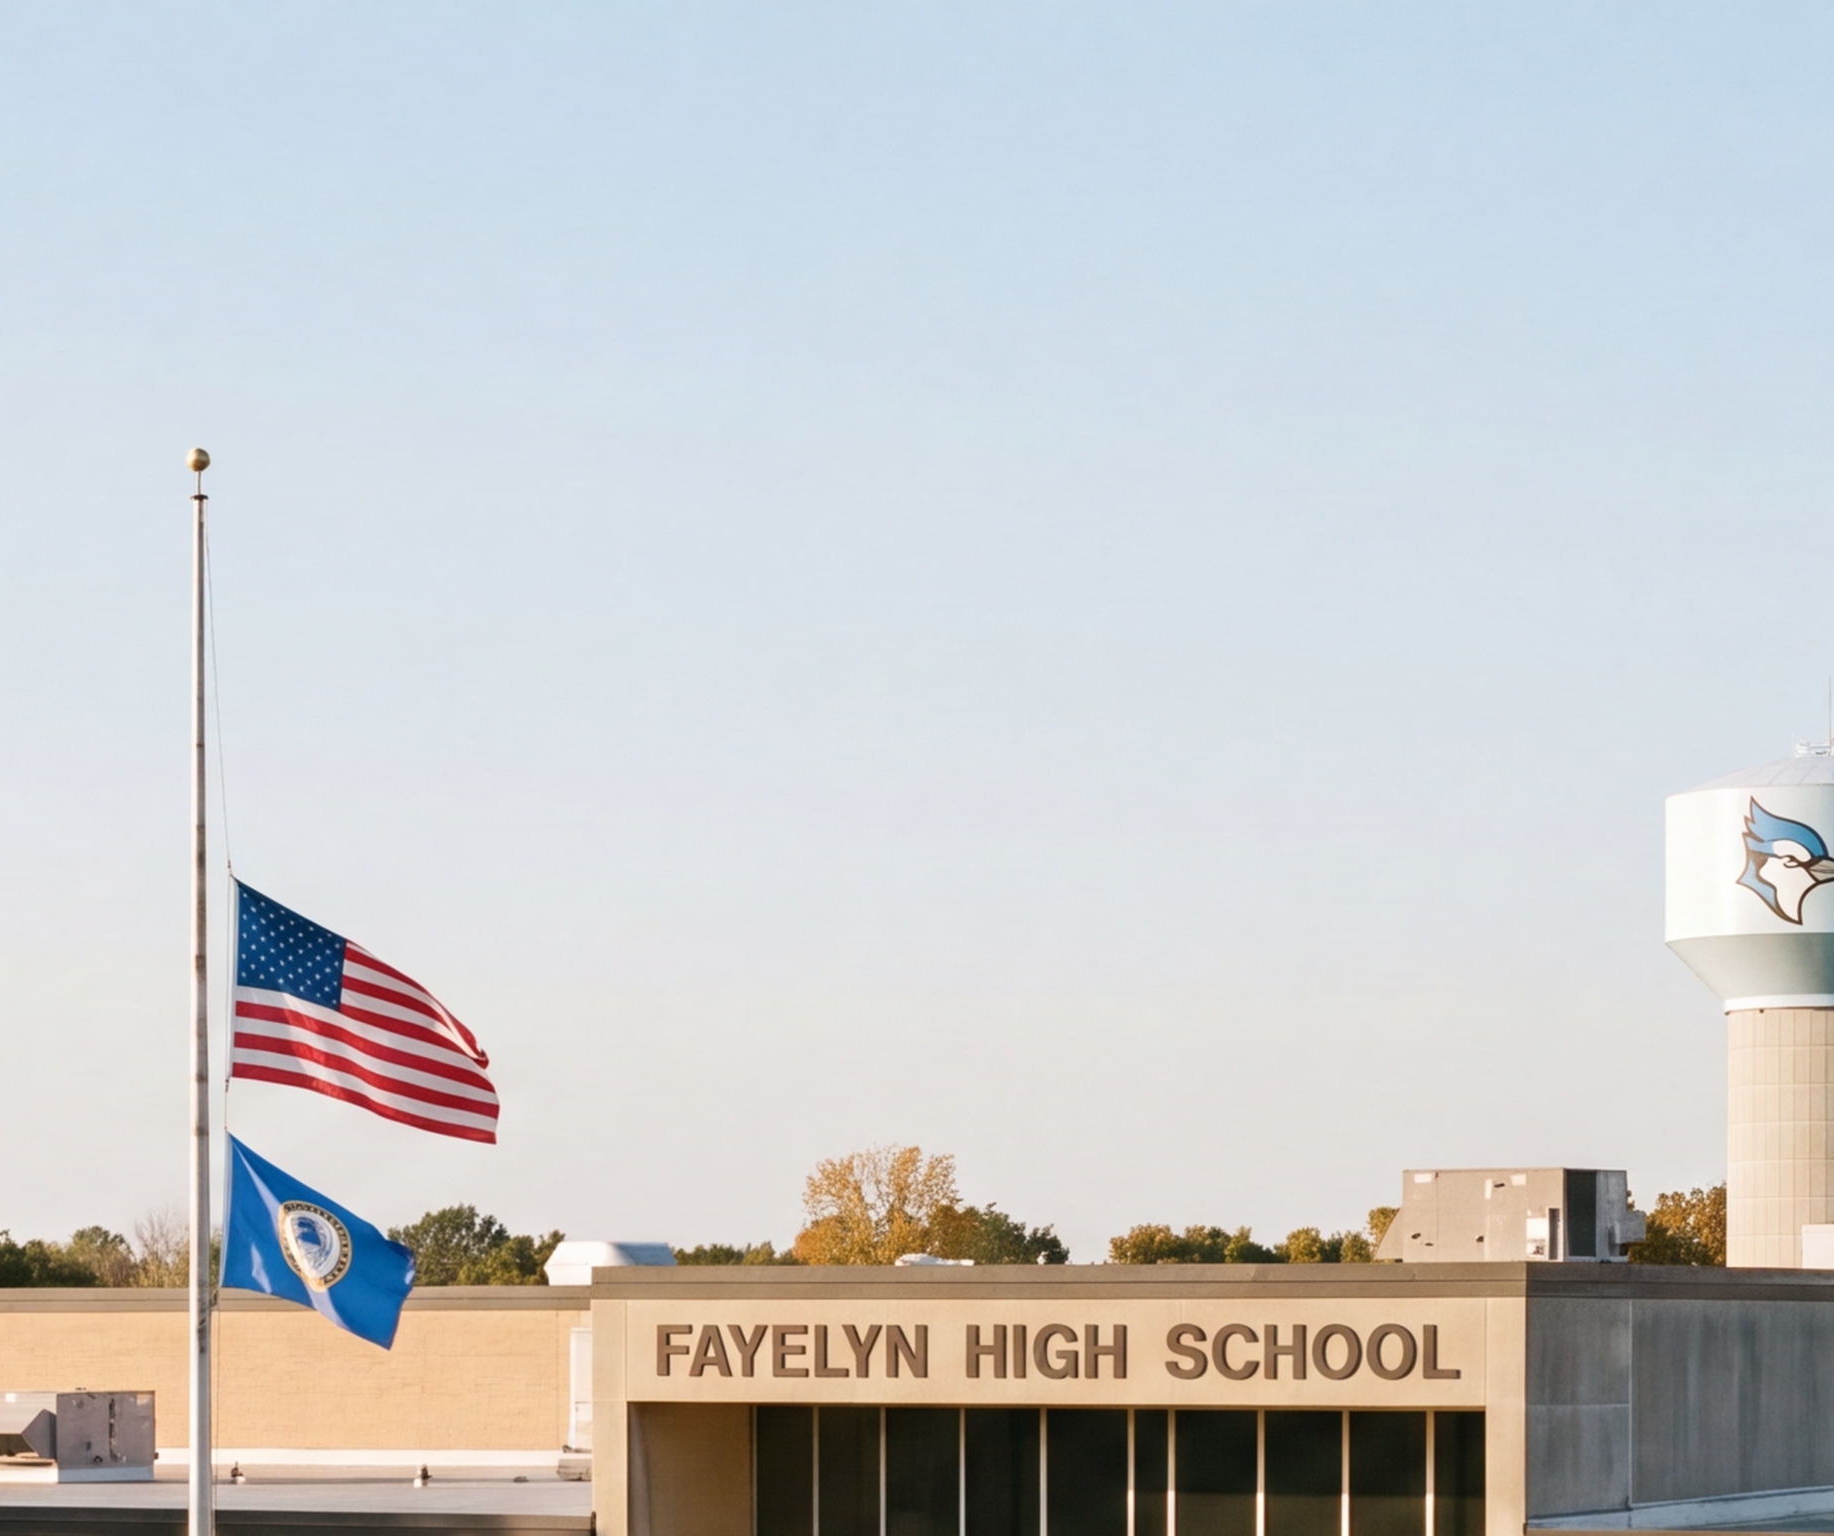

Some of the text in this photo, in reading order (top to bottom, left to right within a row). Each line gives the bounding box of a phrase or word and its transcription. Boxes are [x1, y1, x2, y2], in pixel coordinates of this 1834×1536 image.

[655, 1322, 1461, 1381] FAYELYN HIGH SCHOOL
